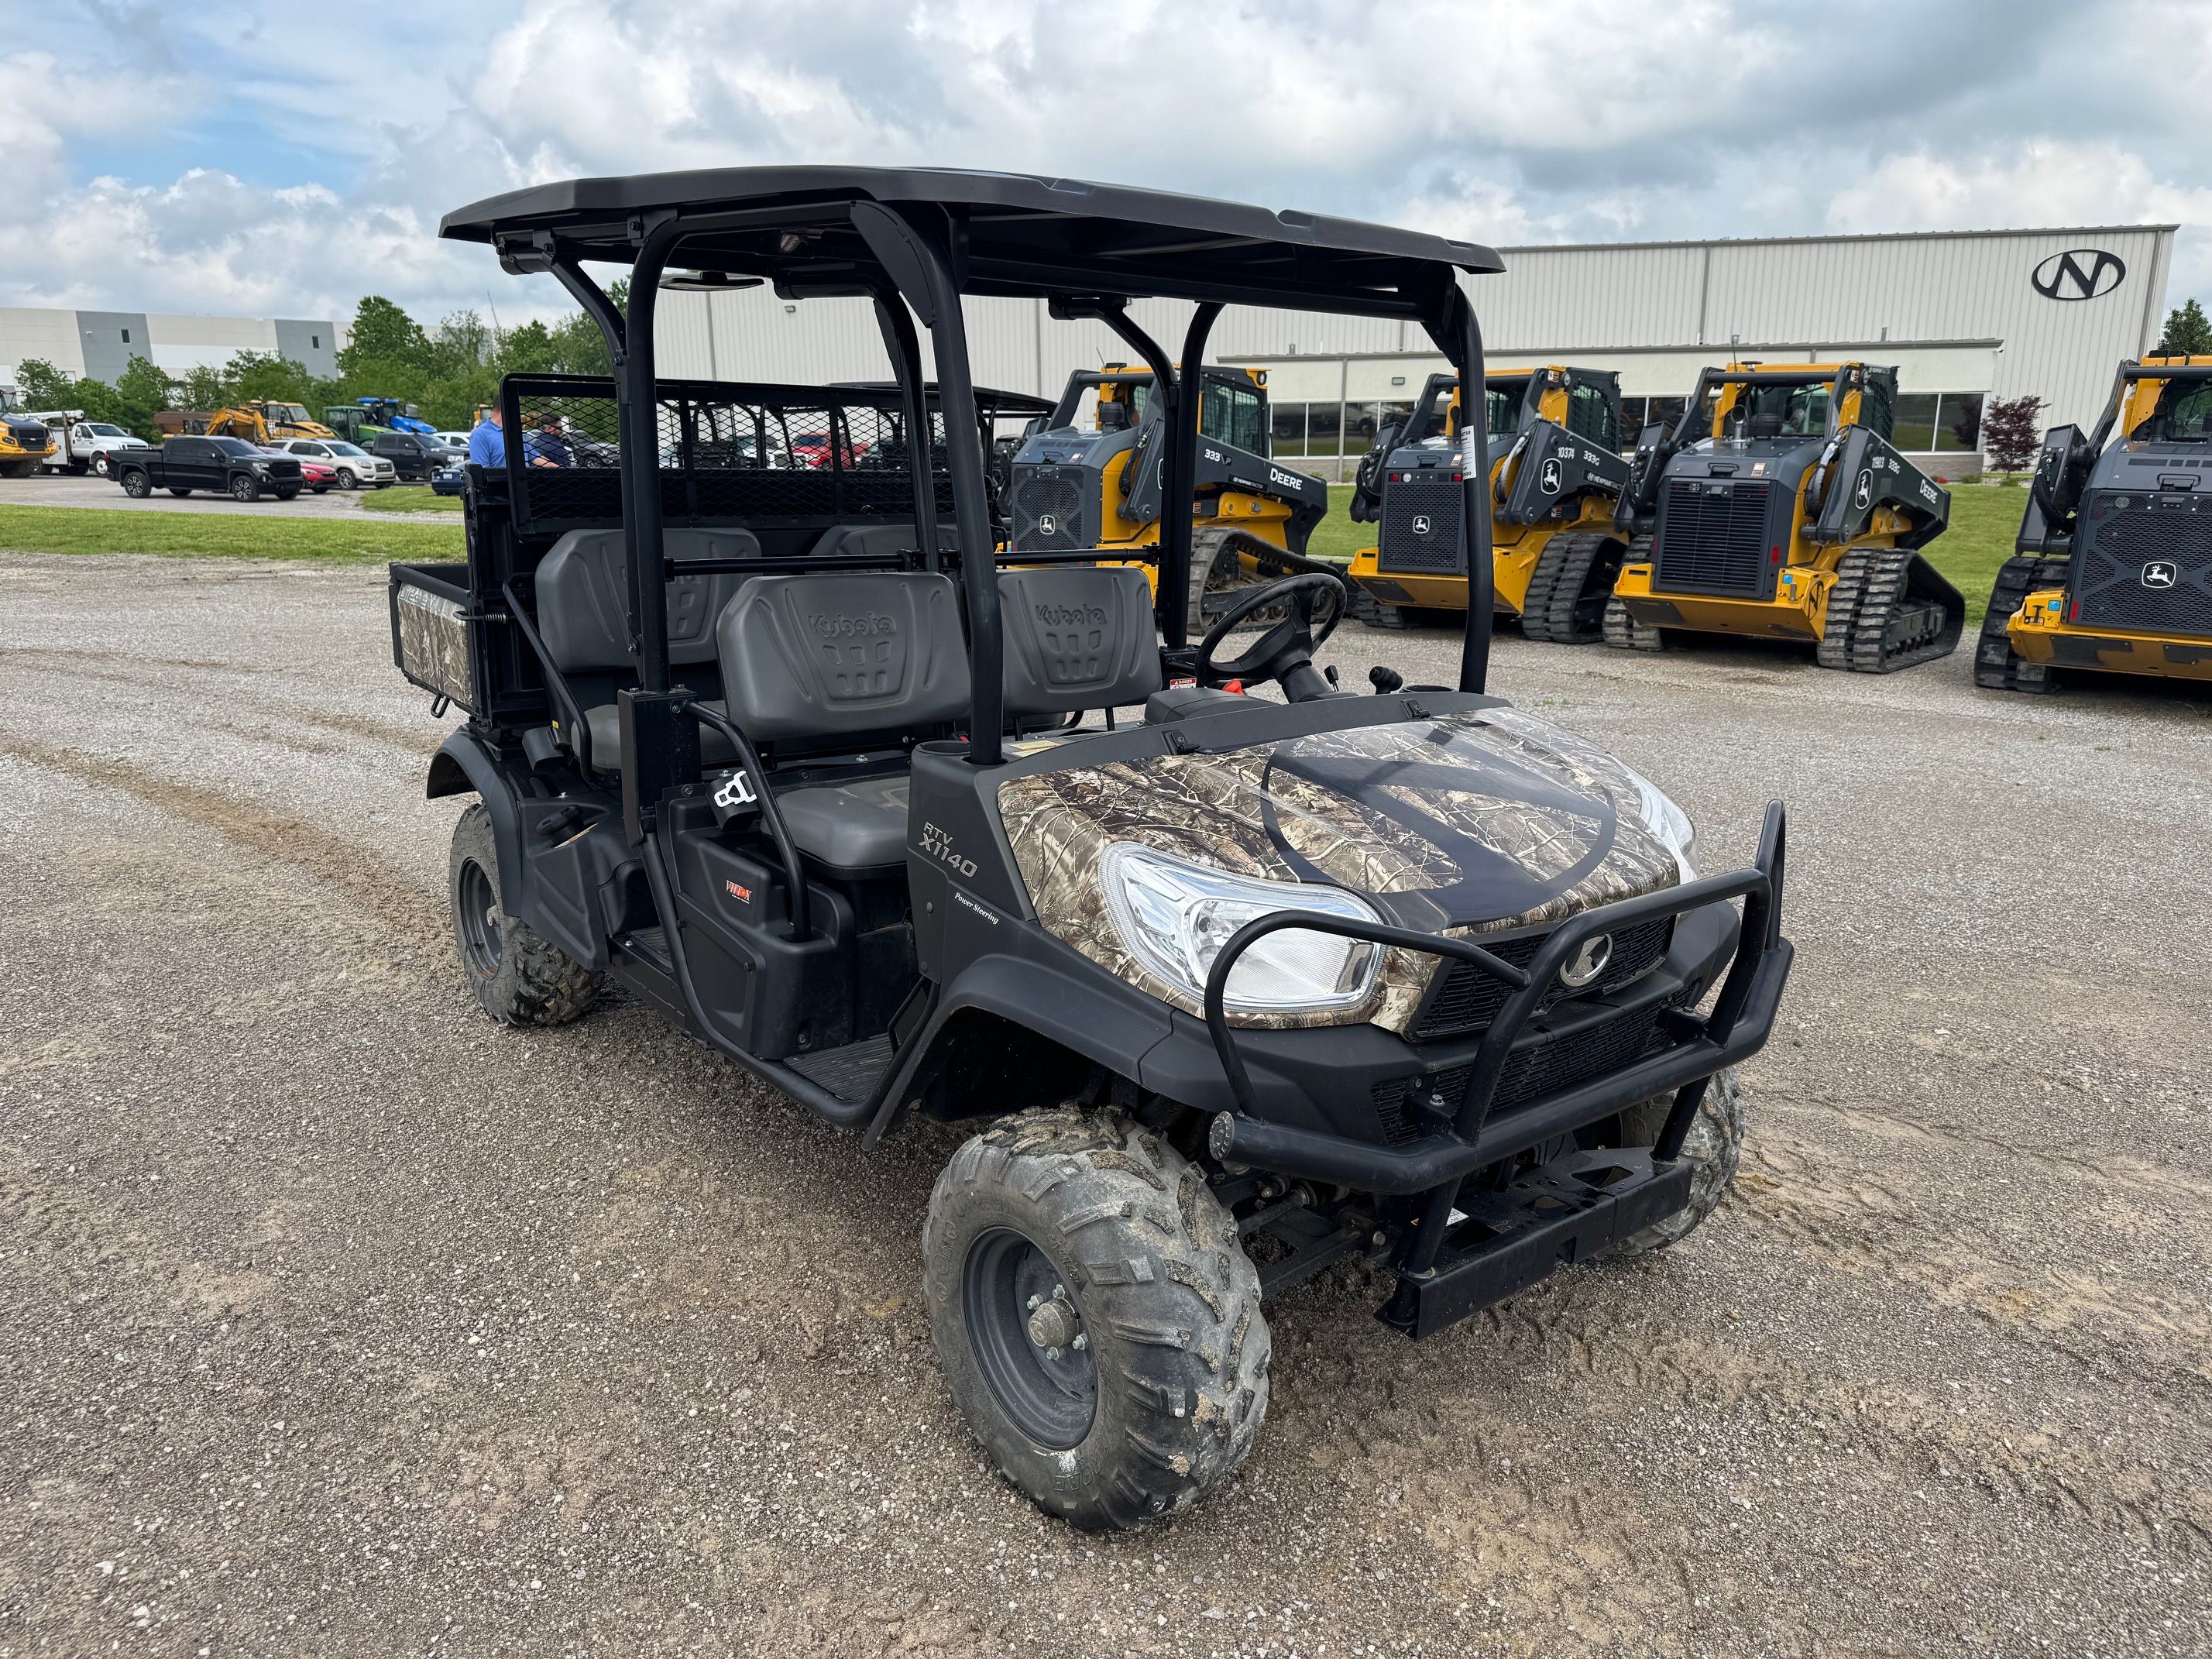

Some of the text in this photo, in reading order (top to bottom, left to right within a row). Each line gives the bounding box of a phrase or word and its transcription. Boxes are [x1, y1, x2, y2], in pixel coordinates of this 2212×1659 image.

[1558, 447, 1575, 459] 10374
[1583, 450, 1600, 466] 333G
[1270, 467, 1303, 491] DEERE
[1919, 479, 1938, 504] DEERE
[806, 612, 897, 637] Kubota
[1036, 604, 1108, 627] Kubota
[923, 822, 953, 845] RTV
[918, 832, 978, 878] X1140
[954, 891, 1000, 925] Power Steering
